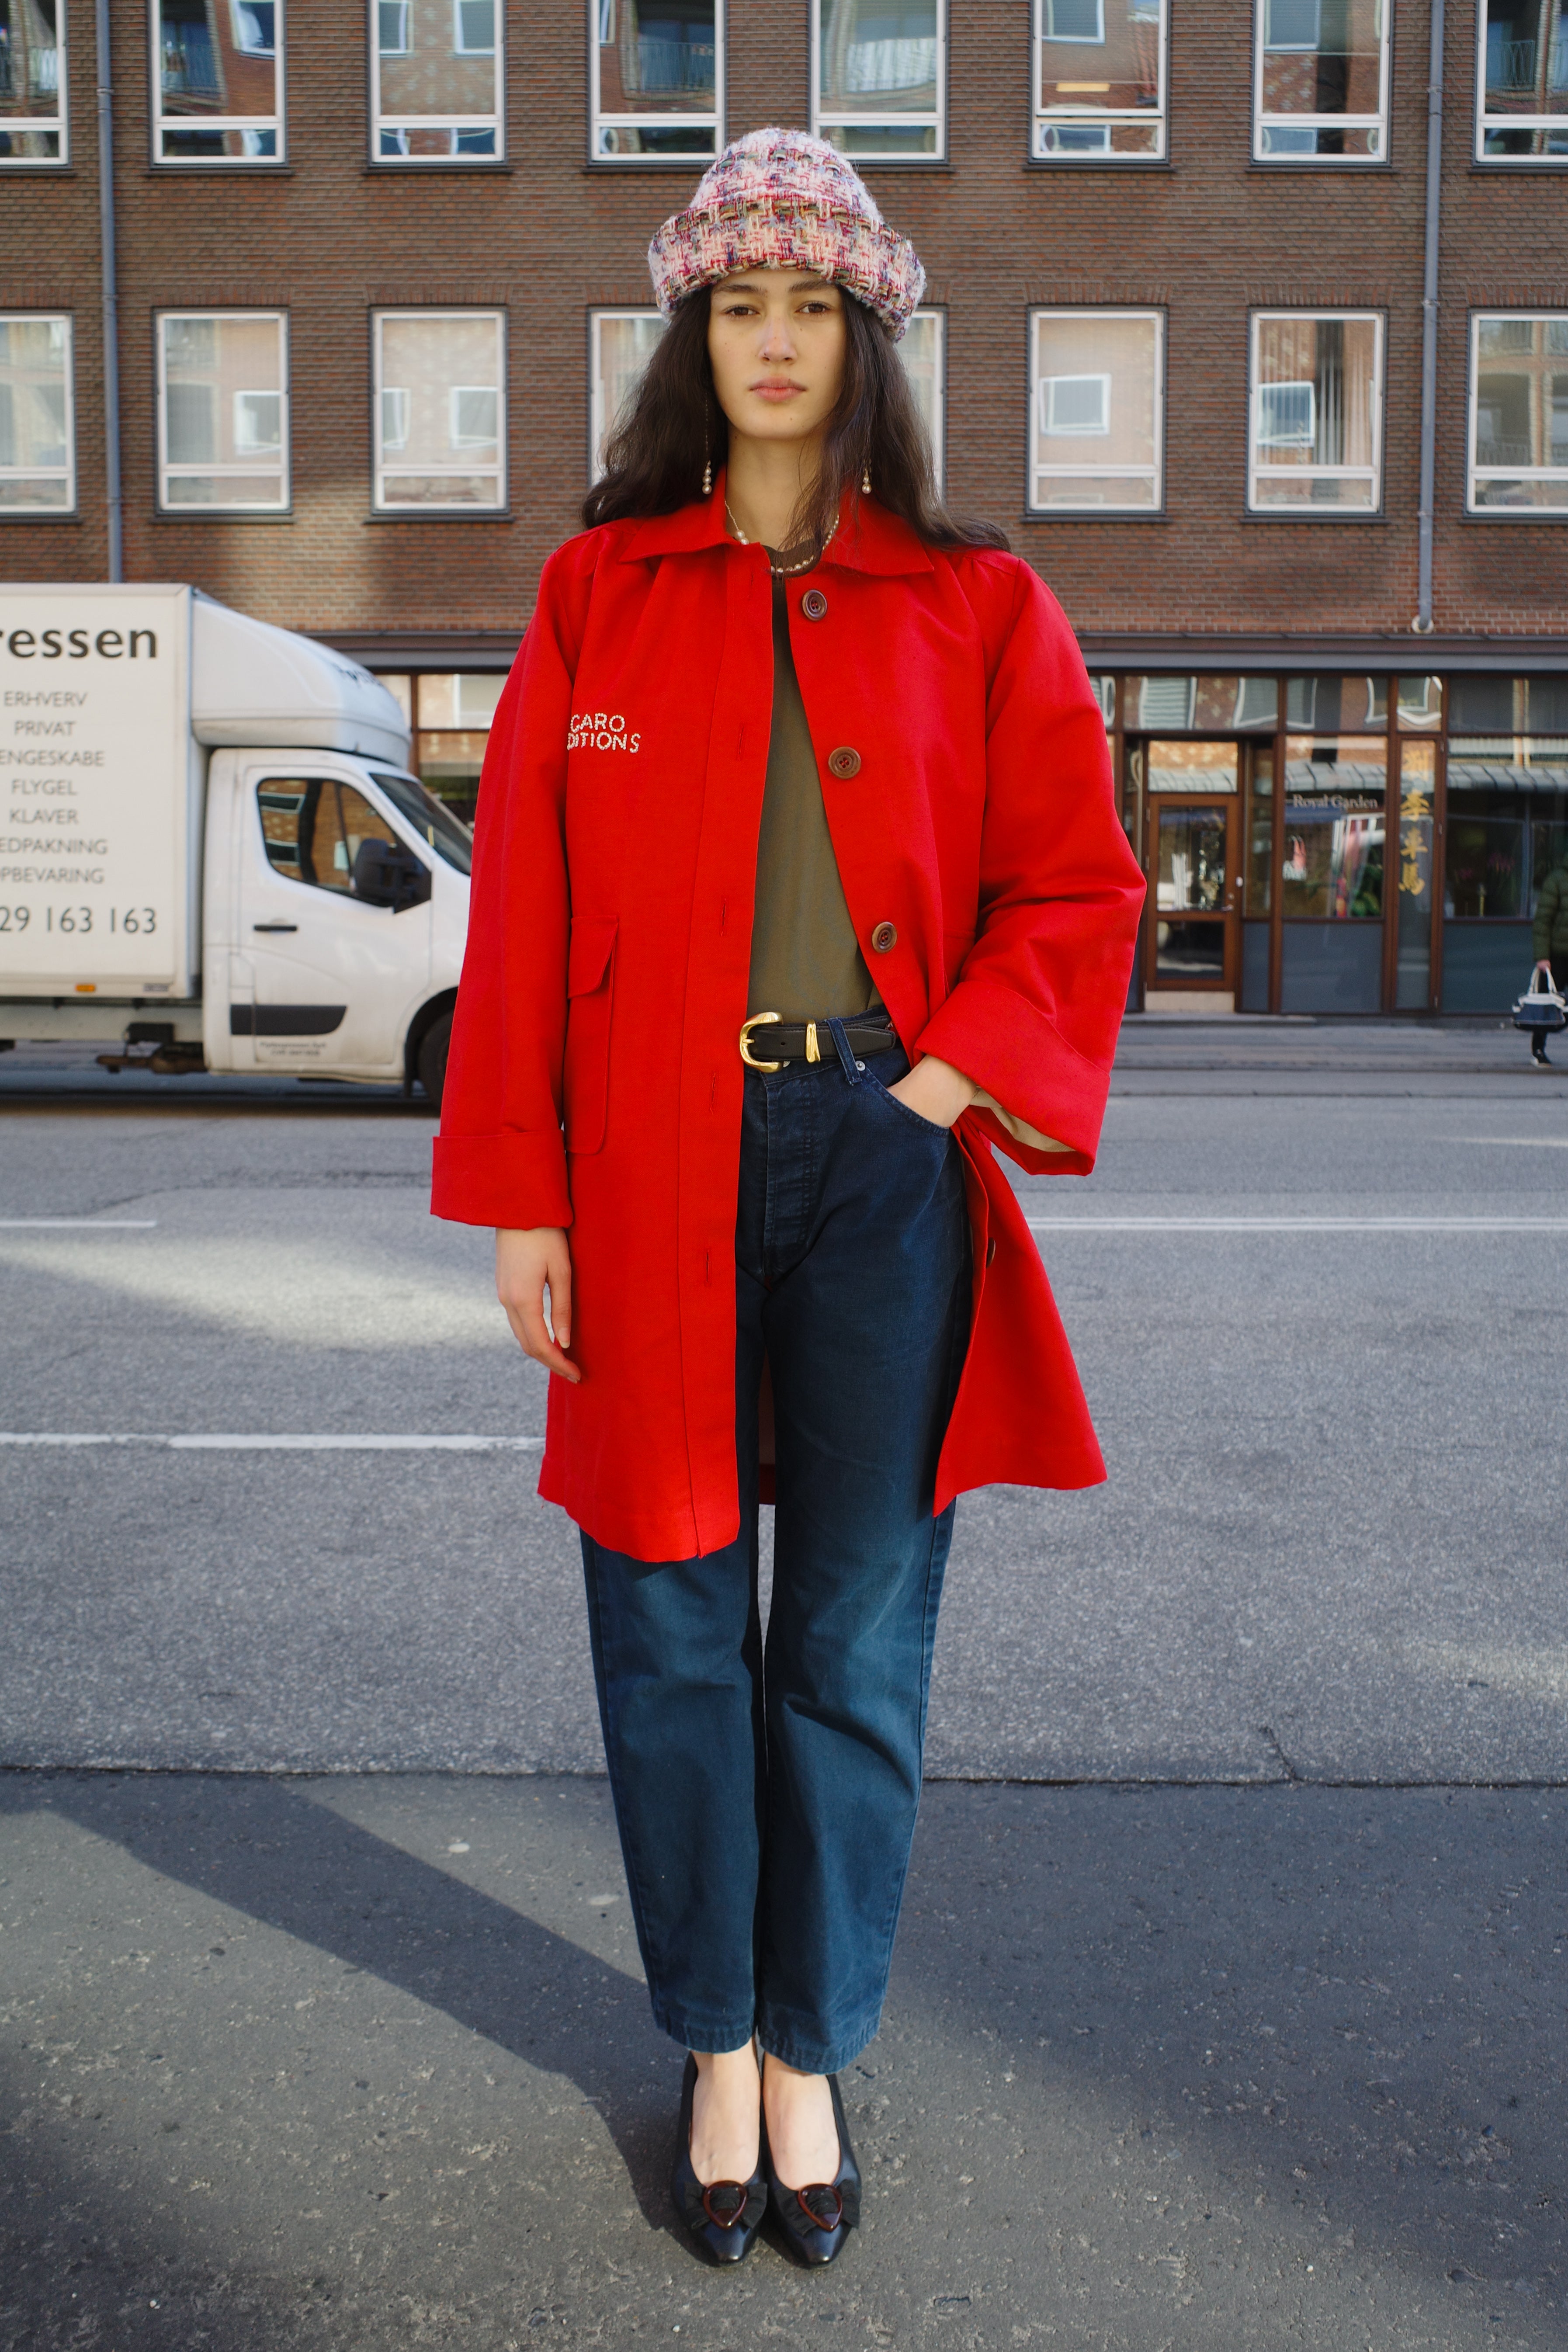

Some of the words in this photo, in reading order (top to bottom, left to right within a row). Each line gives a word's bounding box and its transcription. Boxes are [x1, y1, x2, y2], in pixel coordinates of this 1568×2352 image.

[0, 629, 157, 658] essen
[4, 691, 88, 707] ERHVERV
[14, 720, 76, 736] PRIVAT
[570, 713, 625, 732] CARO
[11, 778, 78, 796] FLYGEL
[1292, 794, 1329, 808] Royal
[1332, 794, 1378, 808] Garden
[9, 808, 79, 825] KLAVER
[47, 907, 92, 933] 163
[111, 907, 157, 934] 163
